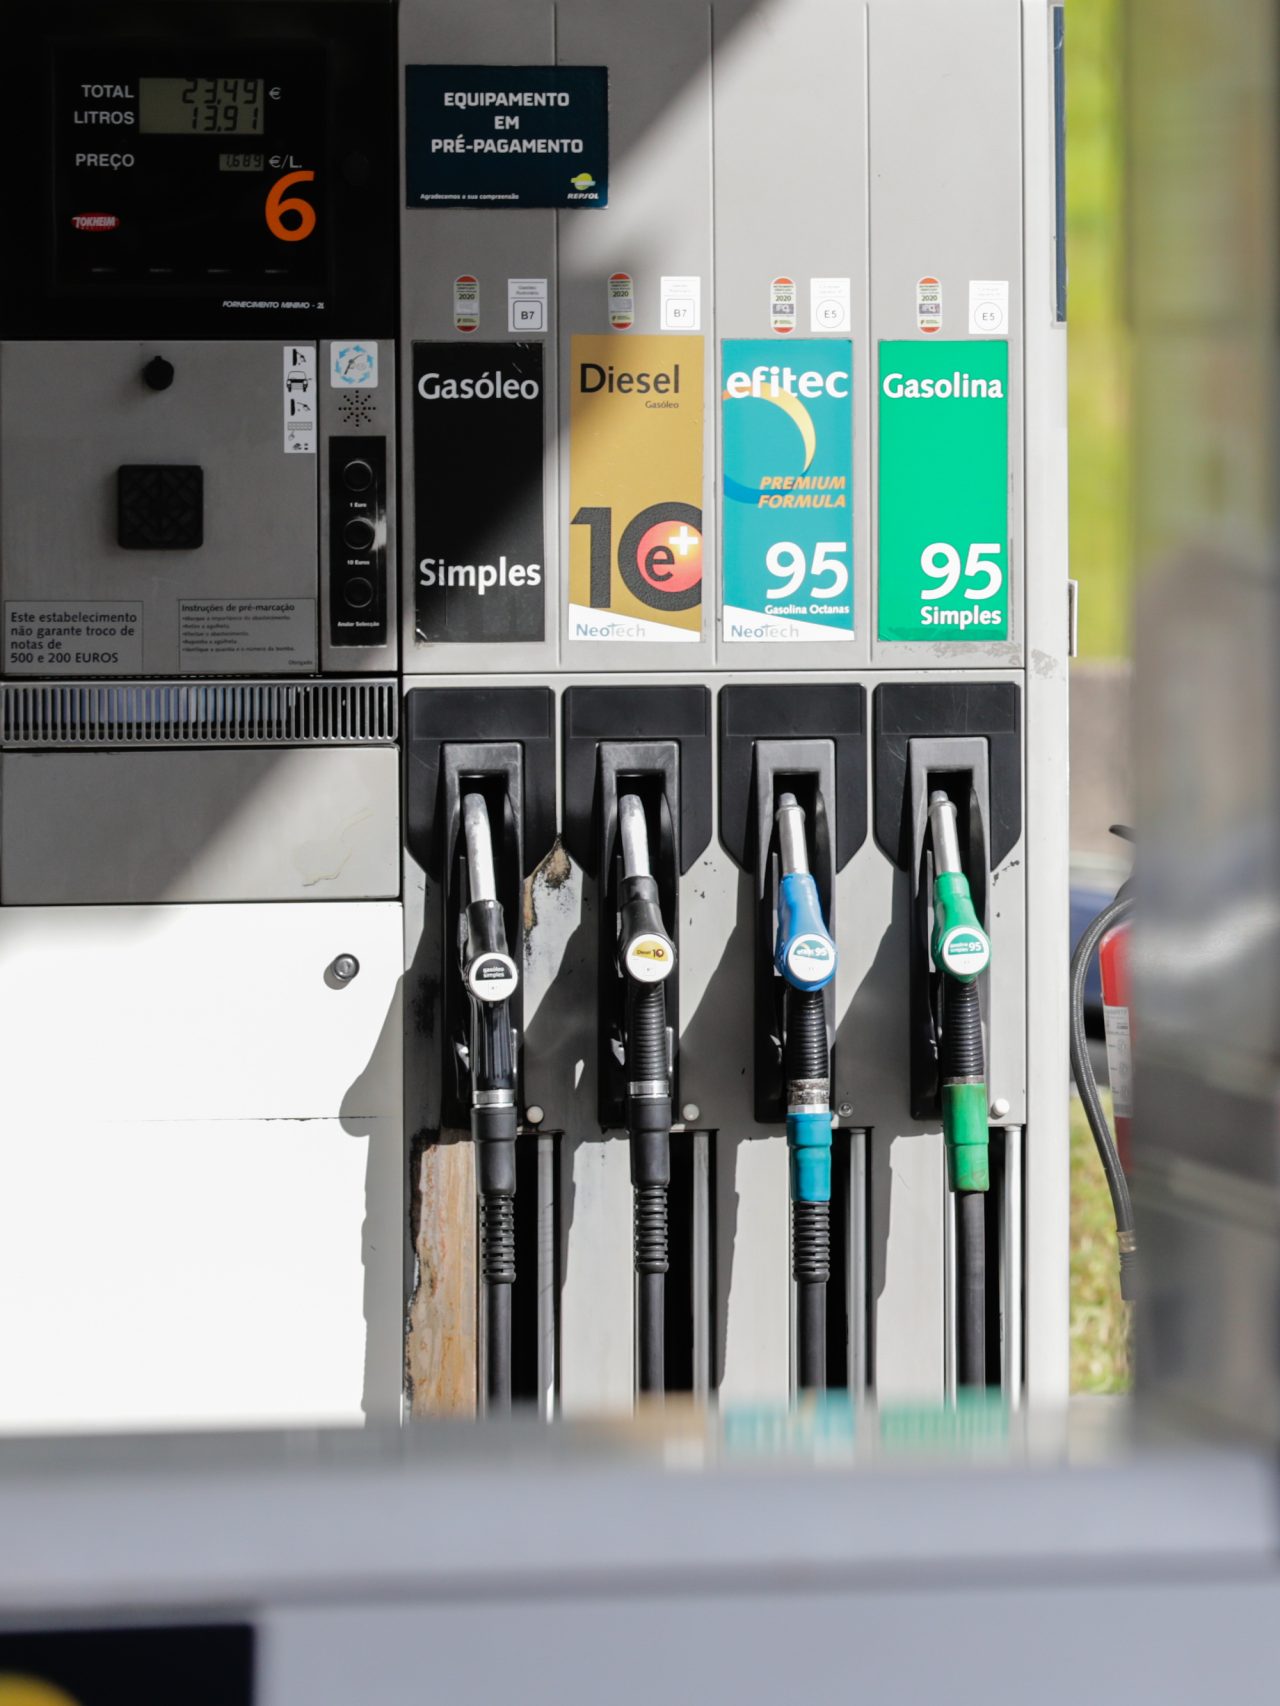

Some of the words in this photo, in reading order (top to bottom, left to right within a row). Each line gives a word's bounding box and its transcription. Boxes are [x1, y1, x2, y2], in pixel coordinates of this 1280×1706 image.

[81, 84, 135, 98] TOTAL
[268, 87, 282, 100] €
[443, 92, 570, 109] EQUIPAMENTO
[73, 111, 135, 125] LITROS
[494, 115, 520, 130] EM
[431, 134, 584, 153] PRÉ-PAGAMENTO
[75, 154, 135, 170] PREÇO
[265, 171, 316, 241] 6
[71, 215, 117, 229] TOKHEIM
[222, 300, 279, 308] FORNECIMENTO
[418, 371, 539, 400] Gasóleo
[580, 363, 680, 394] Diesel
[726, 366, 849, 399] efitec
[883, 371, 1003, 399] Gasolina
[645, 400, 679, 409] Gasóleo
[759, 476, 846, 490] PREMIUM
[758, 494, 846, 508] FORMULA
[419, 555, 542, 595] Simples
[765, 541, 849, 600] 95
[920, 542, 1003, 600] 95
[181, 604, 224, 613] Instruções
[238, 603, 295, 613] pré-marcação
[764, 605, 807, 615] Gasolina
[809, 605, 850, 615] Octanas
[10, 611, 35, 623] Este
[39, 611, 137, 623] estabelecimento
[920, 605, 1002, 630] Simples
[10, 626, 33, 636] não
[36, 626, 82, 639] garante
[86, 626, 117, 636] troco
[120, 625, 135, 636] de
[10, 640, 43, 649] notas
[47, 638, 63, 649] de
[10, 652, 34, 663] 500
[37, 655, 44, 663] e
[48, 652, 71, 663] 200
[75, 652, 118, 663] EUROS
[968, 942, 981, 952] 95
